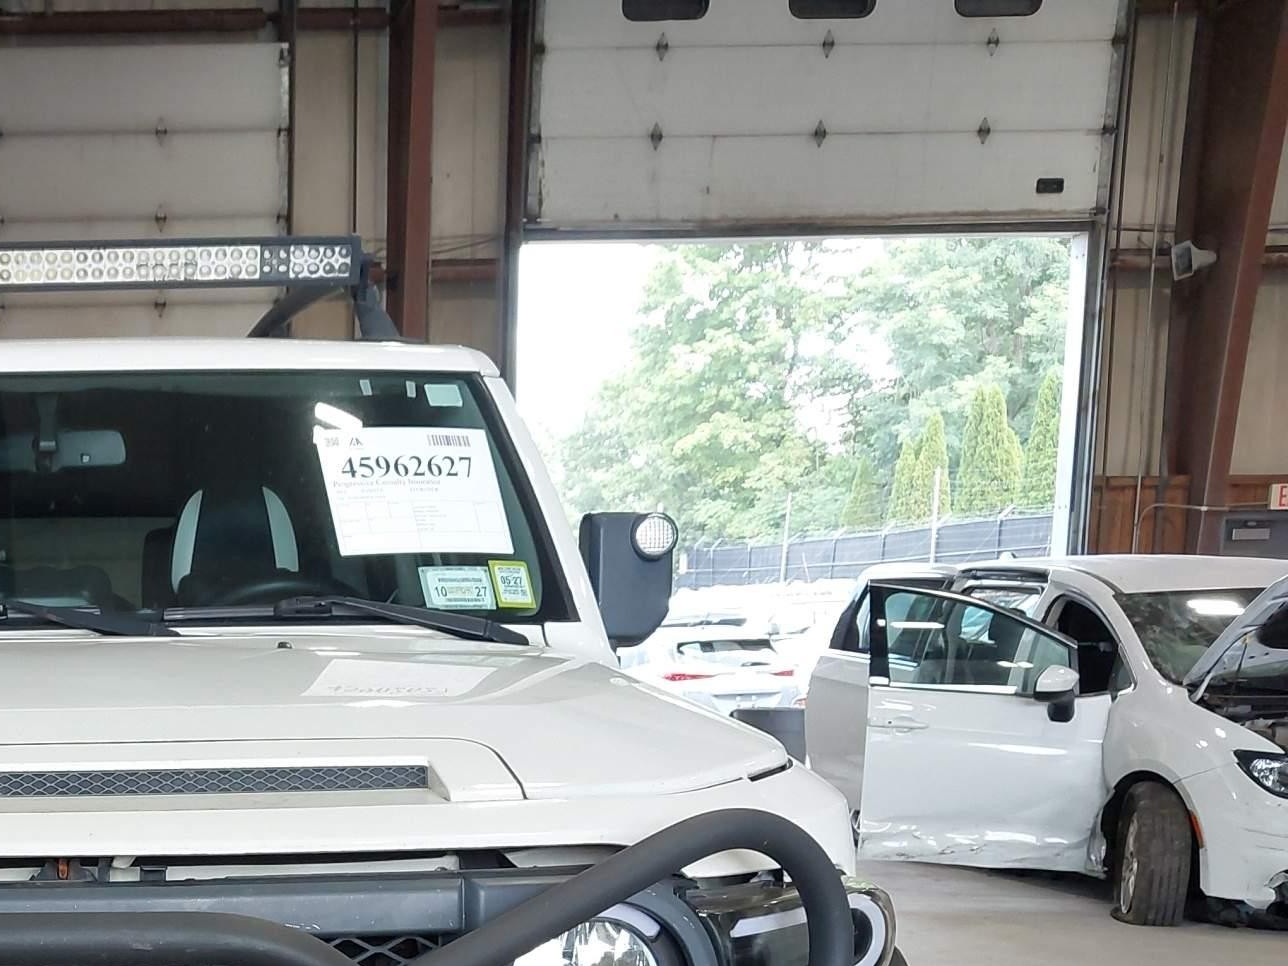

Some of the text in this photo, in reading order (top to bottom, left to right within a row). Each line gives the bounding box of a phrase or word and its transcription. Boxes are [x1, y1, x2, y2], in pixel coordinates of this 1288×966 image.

[341, 455, 472, 478] 45962627
[434, 586, 487, 598] 10 27
